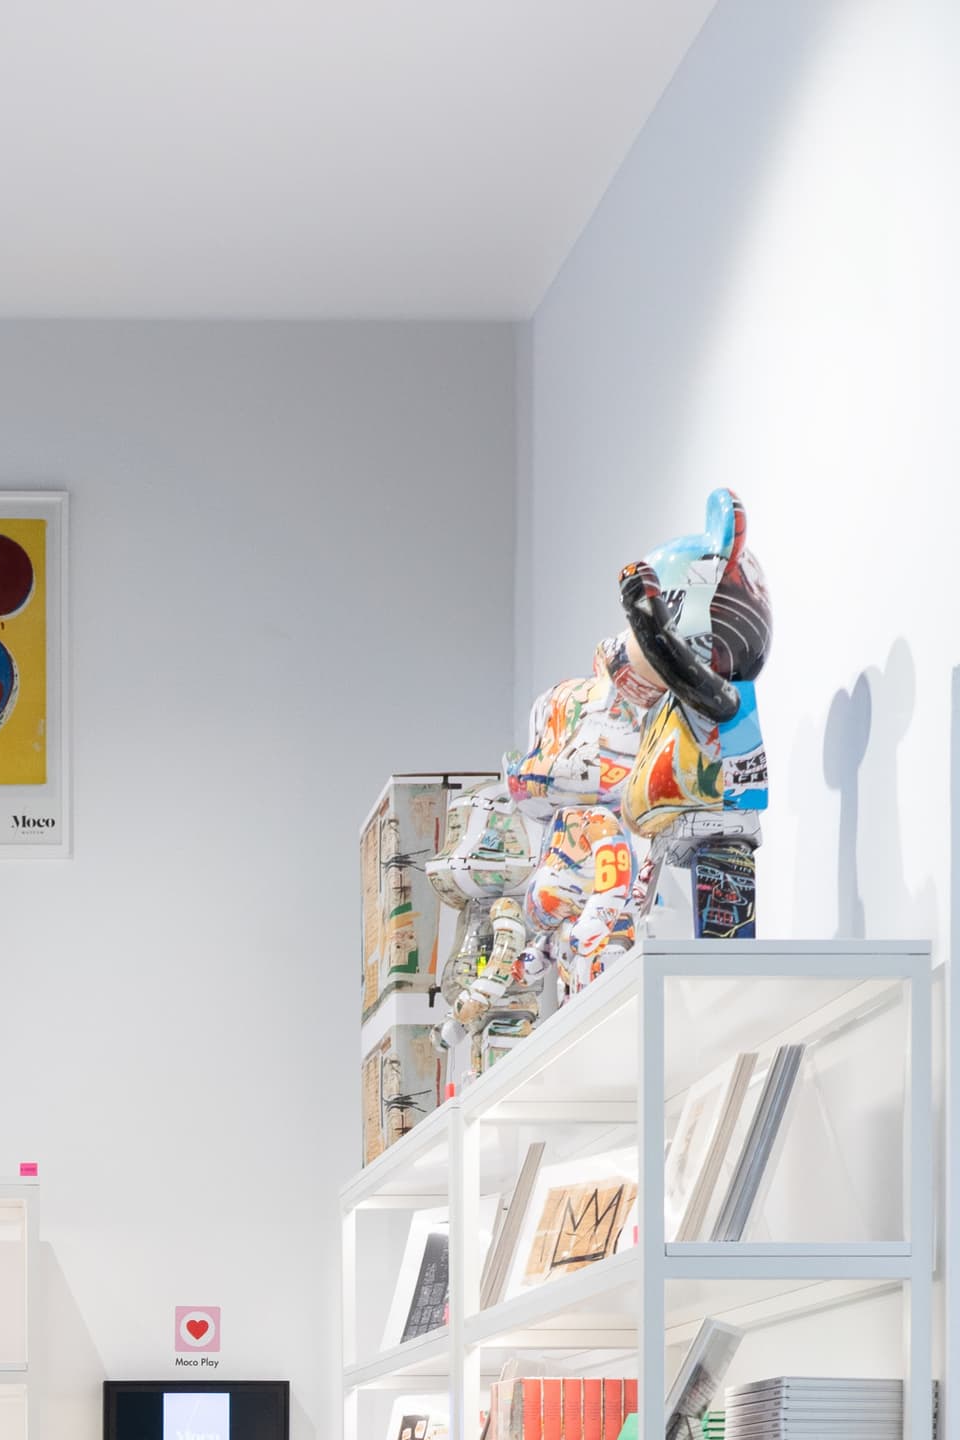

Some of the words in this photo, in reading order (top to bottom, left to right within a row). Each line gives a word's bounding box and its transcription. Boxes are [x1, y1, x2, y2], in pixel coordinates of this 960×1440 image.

[11, 815, 56, 829] Moco
[595, 849, 630, 892] 69
[175, 1357, 199, 1367] Moco
[201, 1356, 220, 1369] Play
